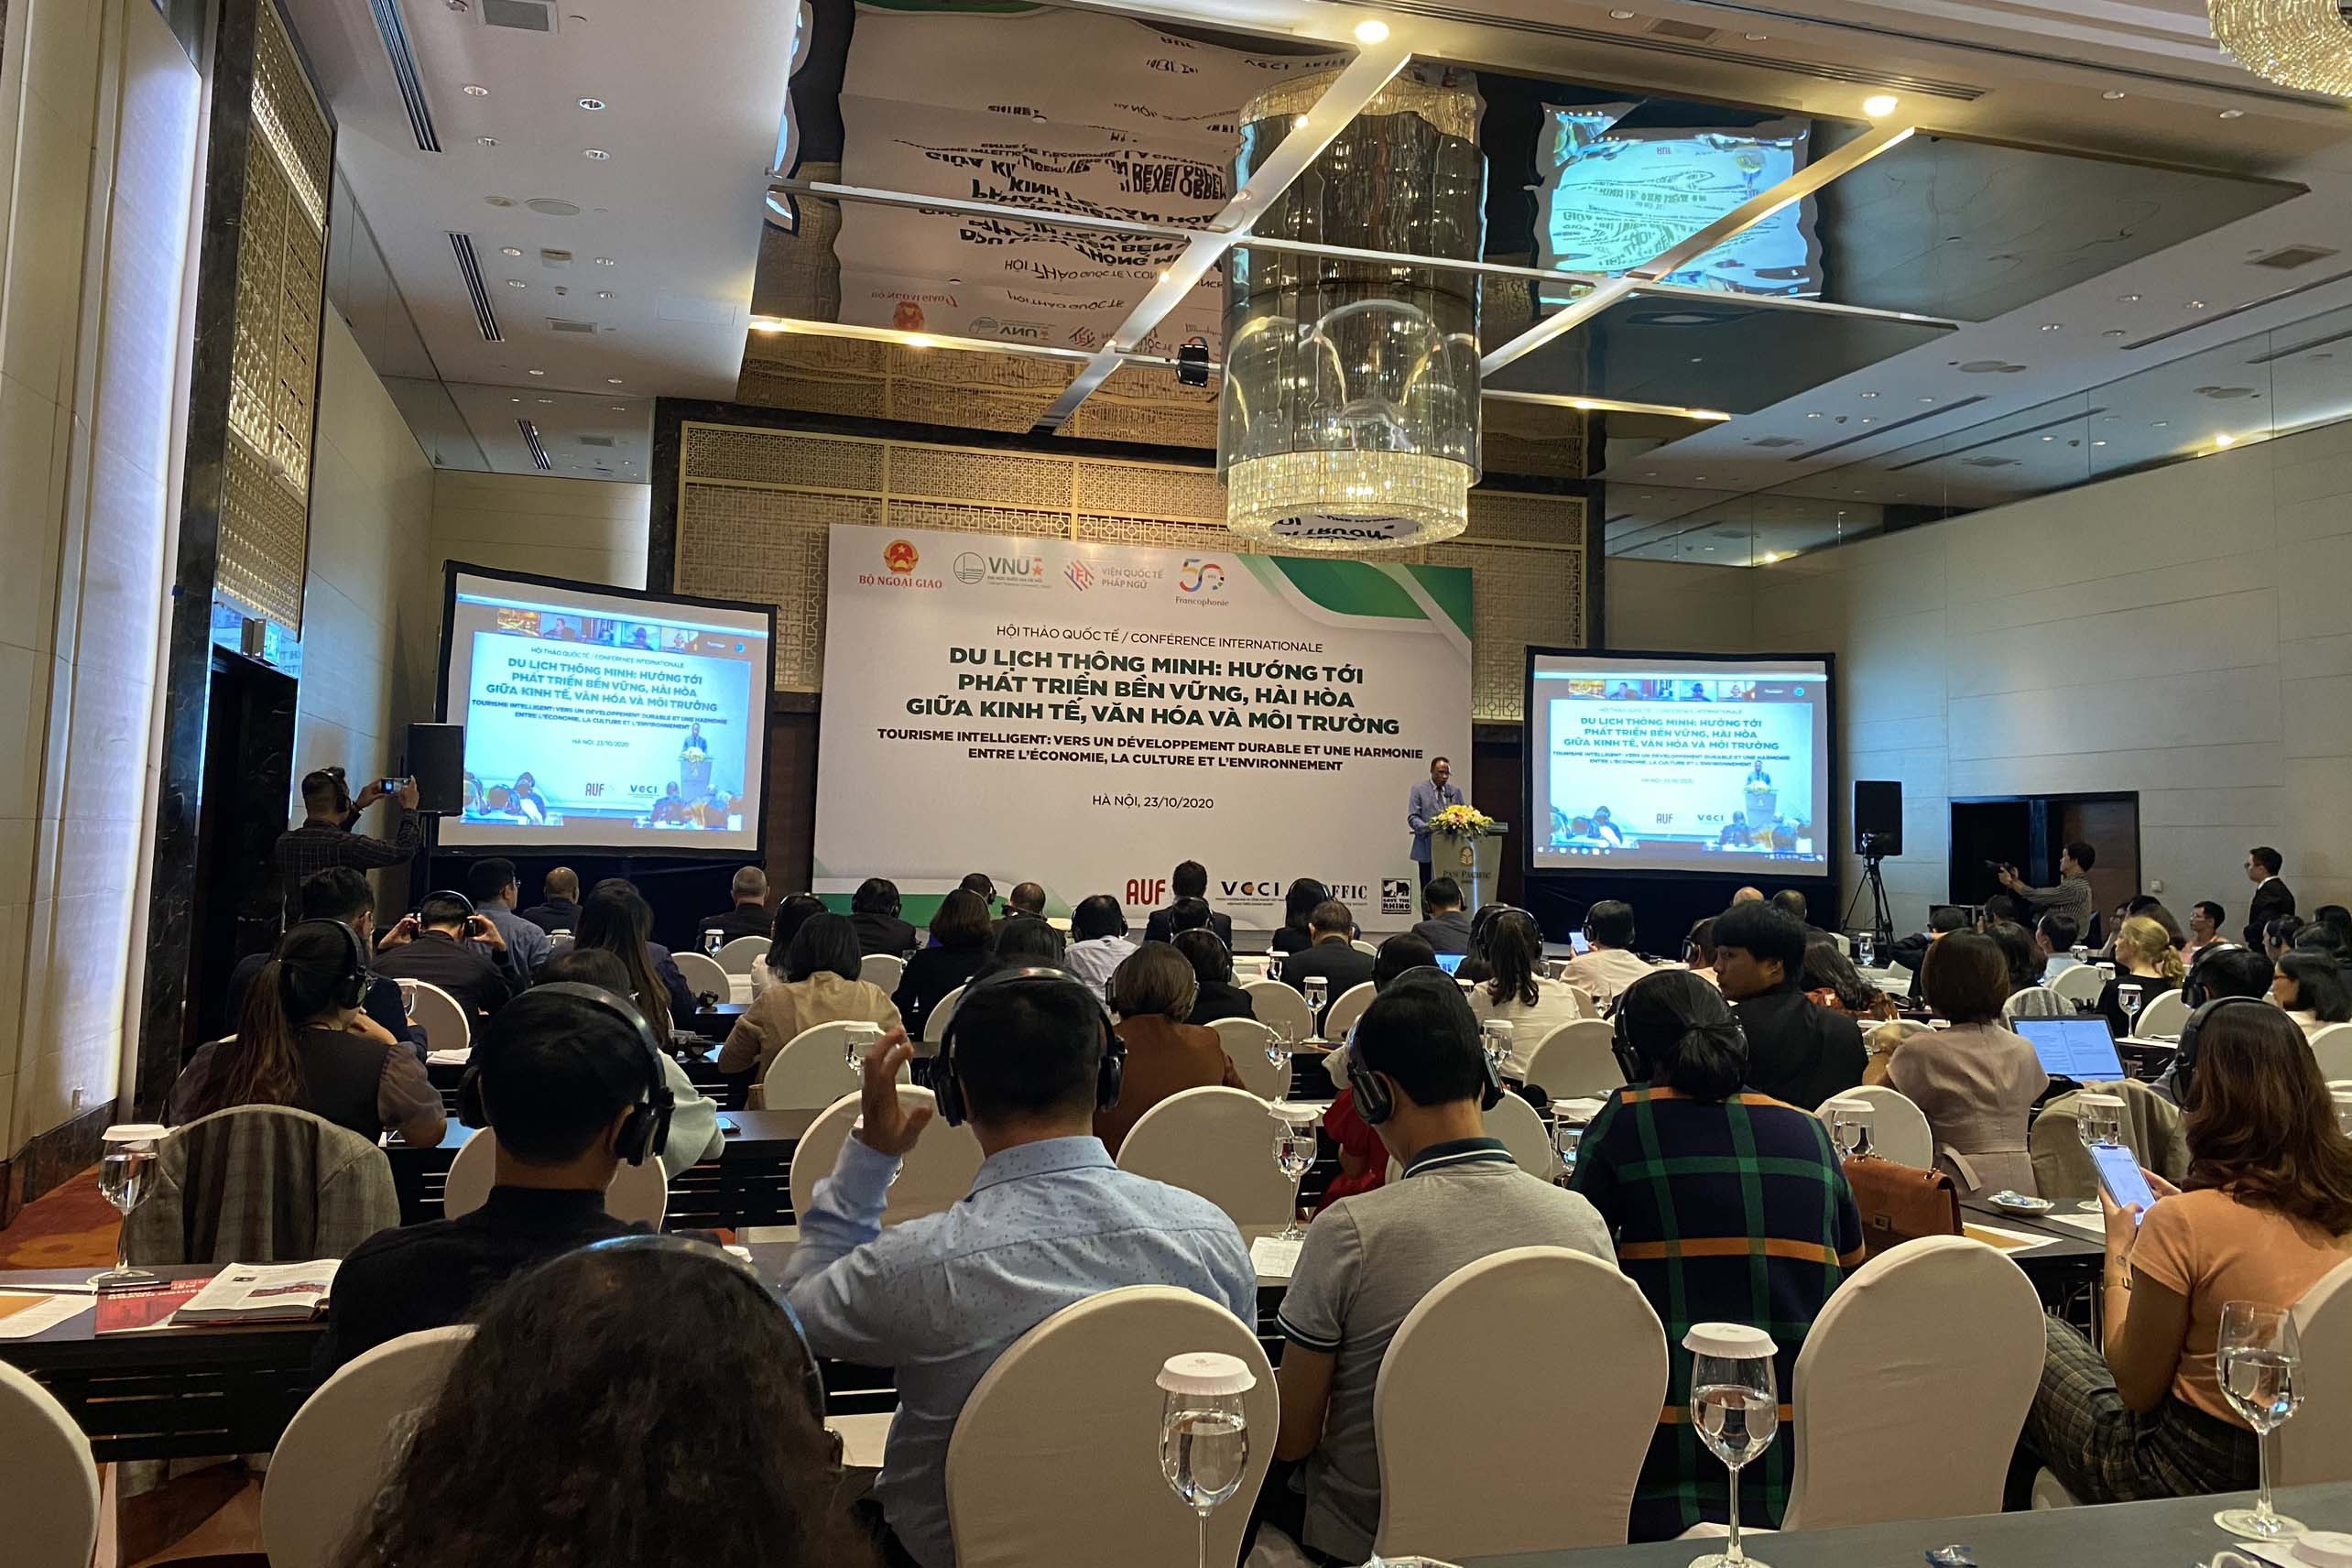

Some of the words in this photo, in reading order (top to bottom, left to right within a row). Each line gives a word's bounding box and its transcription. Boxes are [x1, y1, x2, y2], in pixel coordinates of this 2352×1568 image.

[988, 557, 1029, 575] VNU
[1101, 565, 1123, 578] VIỆN
[1123, 565, 1150, 580] QUỐC
[1152, 567, 1164, 580] TẾ
[859, 573, 875, 586] BỘ
[877, 575, 912, 589] NGOẠI
[916, 579, 942, 589] GIAO
[1102, 577, 1125, 588] PHÁP
[1127, 580, 1148, 589] NGỮ
[1175, 596, 1229, 607] Francophonie
[996, 624, 1019, 638] HỘI
[1022, 625, 1060, 638] THẢO
[1062, 626, 1101, 641] QUỐC
[1103, 628, 1120, 642] TẾ
[1121, 632, 1129, 644] /
[1131, 632, 1215, 648] CONFÉRENCE
[1219, 637, 1323, 653] INTERNATIONALE
[507, 658, 527, 668] DU
[529, 659, 557, 672] LỊCH
[560, 659, 601, 676] THÔNG
[604, 668, 637, 679] MINH:
[639, 670, 681, 683] HƯỚNG
[682, 673, 703, 685] TỚI
[950, 647, 987, 666] DU
[994, 649, 1052, 672] LỊCH
[1057, 650, 1145, 671] THÔNG
[1152, 657, 1222, 676] MINH:
[1228, 659, 1318, 681] HƯỚNG
[1323, 663, 1363, 684] TỚI
[512, 670, 545, 683] PHÁT
[673, 686, 697, 697] HÒA
[959, 671, 1028, 692] PHÁT
[1032, 671, 1108, 696] TRIỂN
[1115, 674, 1164, 698] BỀN
[1170, 681, 1248, 705] VỮNG,
[1256, 685, 1297, 704] HÀI
[1303, 687, 1355, 708] HÒA
[486, 682, 518, 695] GIỮA
[521, 687, 551, 699] KINH
[603, 692, 626, 704] HÓA
[629, 694, 644, 705] VÀ
[472, 699, 508, 708] TOURISME
[593, 717, 622, 725] CULTURE
[906, 694, 973, 717] GIỮA
[980, 701, 1043, 719] KINH
[1048, 697, 1087, 724] TẾ,
[1091, 702, 1144, 724] VĂN
[1151, 705, 1204, 727] HÓA
[1208, 707, 1242, 727] VÀ
[1248, 710, 1292, 730] MÔI
[1297, 713, 1399, 735] TRƯỜNG
[1584, 726, 1614, 735] PHÁT
[877, 728, 953, 741] TOURISME
[957, 732, 1051, 746] INTELLIGENT:
[1053, 735, 1091, 746] VERS
[1094, 736, 1114, 747] UN
[1117, 735, 1235, 752] DÉVELOPPEMENT
[1238, 743, 1301, 755] DURABLE
[1304, 745, 1321, 755] ET
[1323, 746, 1351, 757] UNE
[1354, 746, 1423, 759] HARMONIE
[968, 748, 1015, 760] ENTRE
[1111, 753, 1130, 764] LA
[1132, 754, 1194, 766] CULTURE
[1198, 756, 1215, 767] ET
[585, 782, 604, 797] AUF
[1093, 793, 1112, 806] HÀ
[1114, 793, 1140, 809] NỘI,
[1144, 794, 1214, 810] 23/10/2020
[1656, 812, 1673, 824] AUF
[1126, 878, 1166, 906] AUF
[1221, 881, 1279, 897] VCCI
[1331, 885, 1368, 899] FFIC
